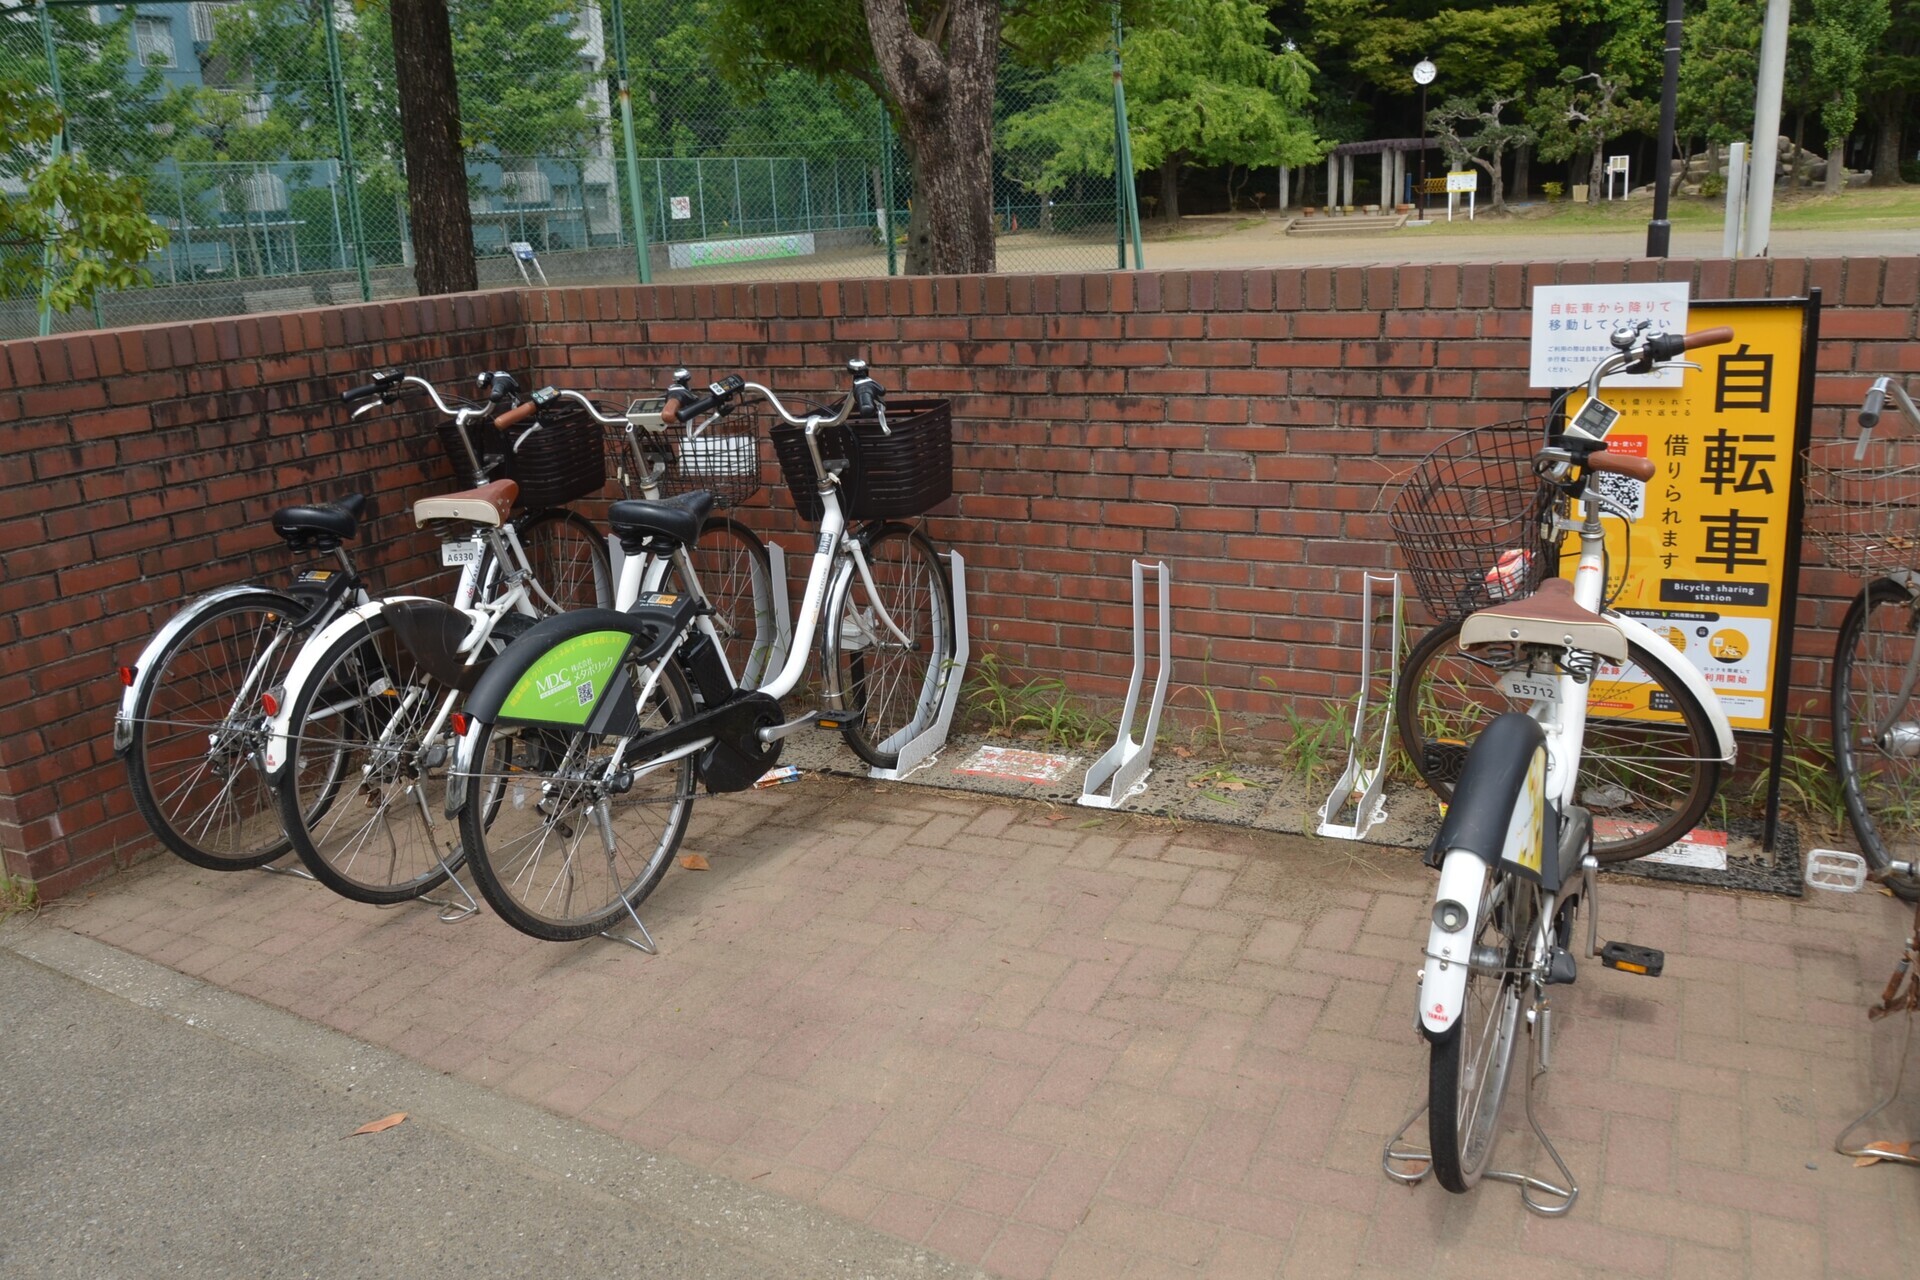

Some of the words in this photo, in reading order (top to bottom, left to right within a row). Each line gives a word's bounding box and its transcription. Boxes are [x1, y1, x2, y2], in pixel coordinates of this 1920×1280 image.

[1550, 301, 1672, 315] 自転車から降りて
[1548, 317, 1672, 331] 移動してください
[1695, 344, 1776, 574] 自転車
[1659, 434, 1689, 569] 借りられます
[447, 552, 474, 562] A6330
[1674, 582, 1710, 592] Bicycle
[1716, 583, 1755, 596] sharing
[1694, 593, 1732, 602] station
[535, 667, 570, 694] MDC
[1704, 673, 1748, 684] 利用開始
[1512, 683, 1556, 698] B5712
